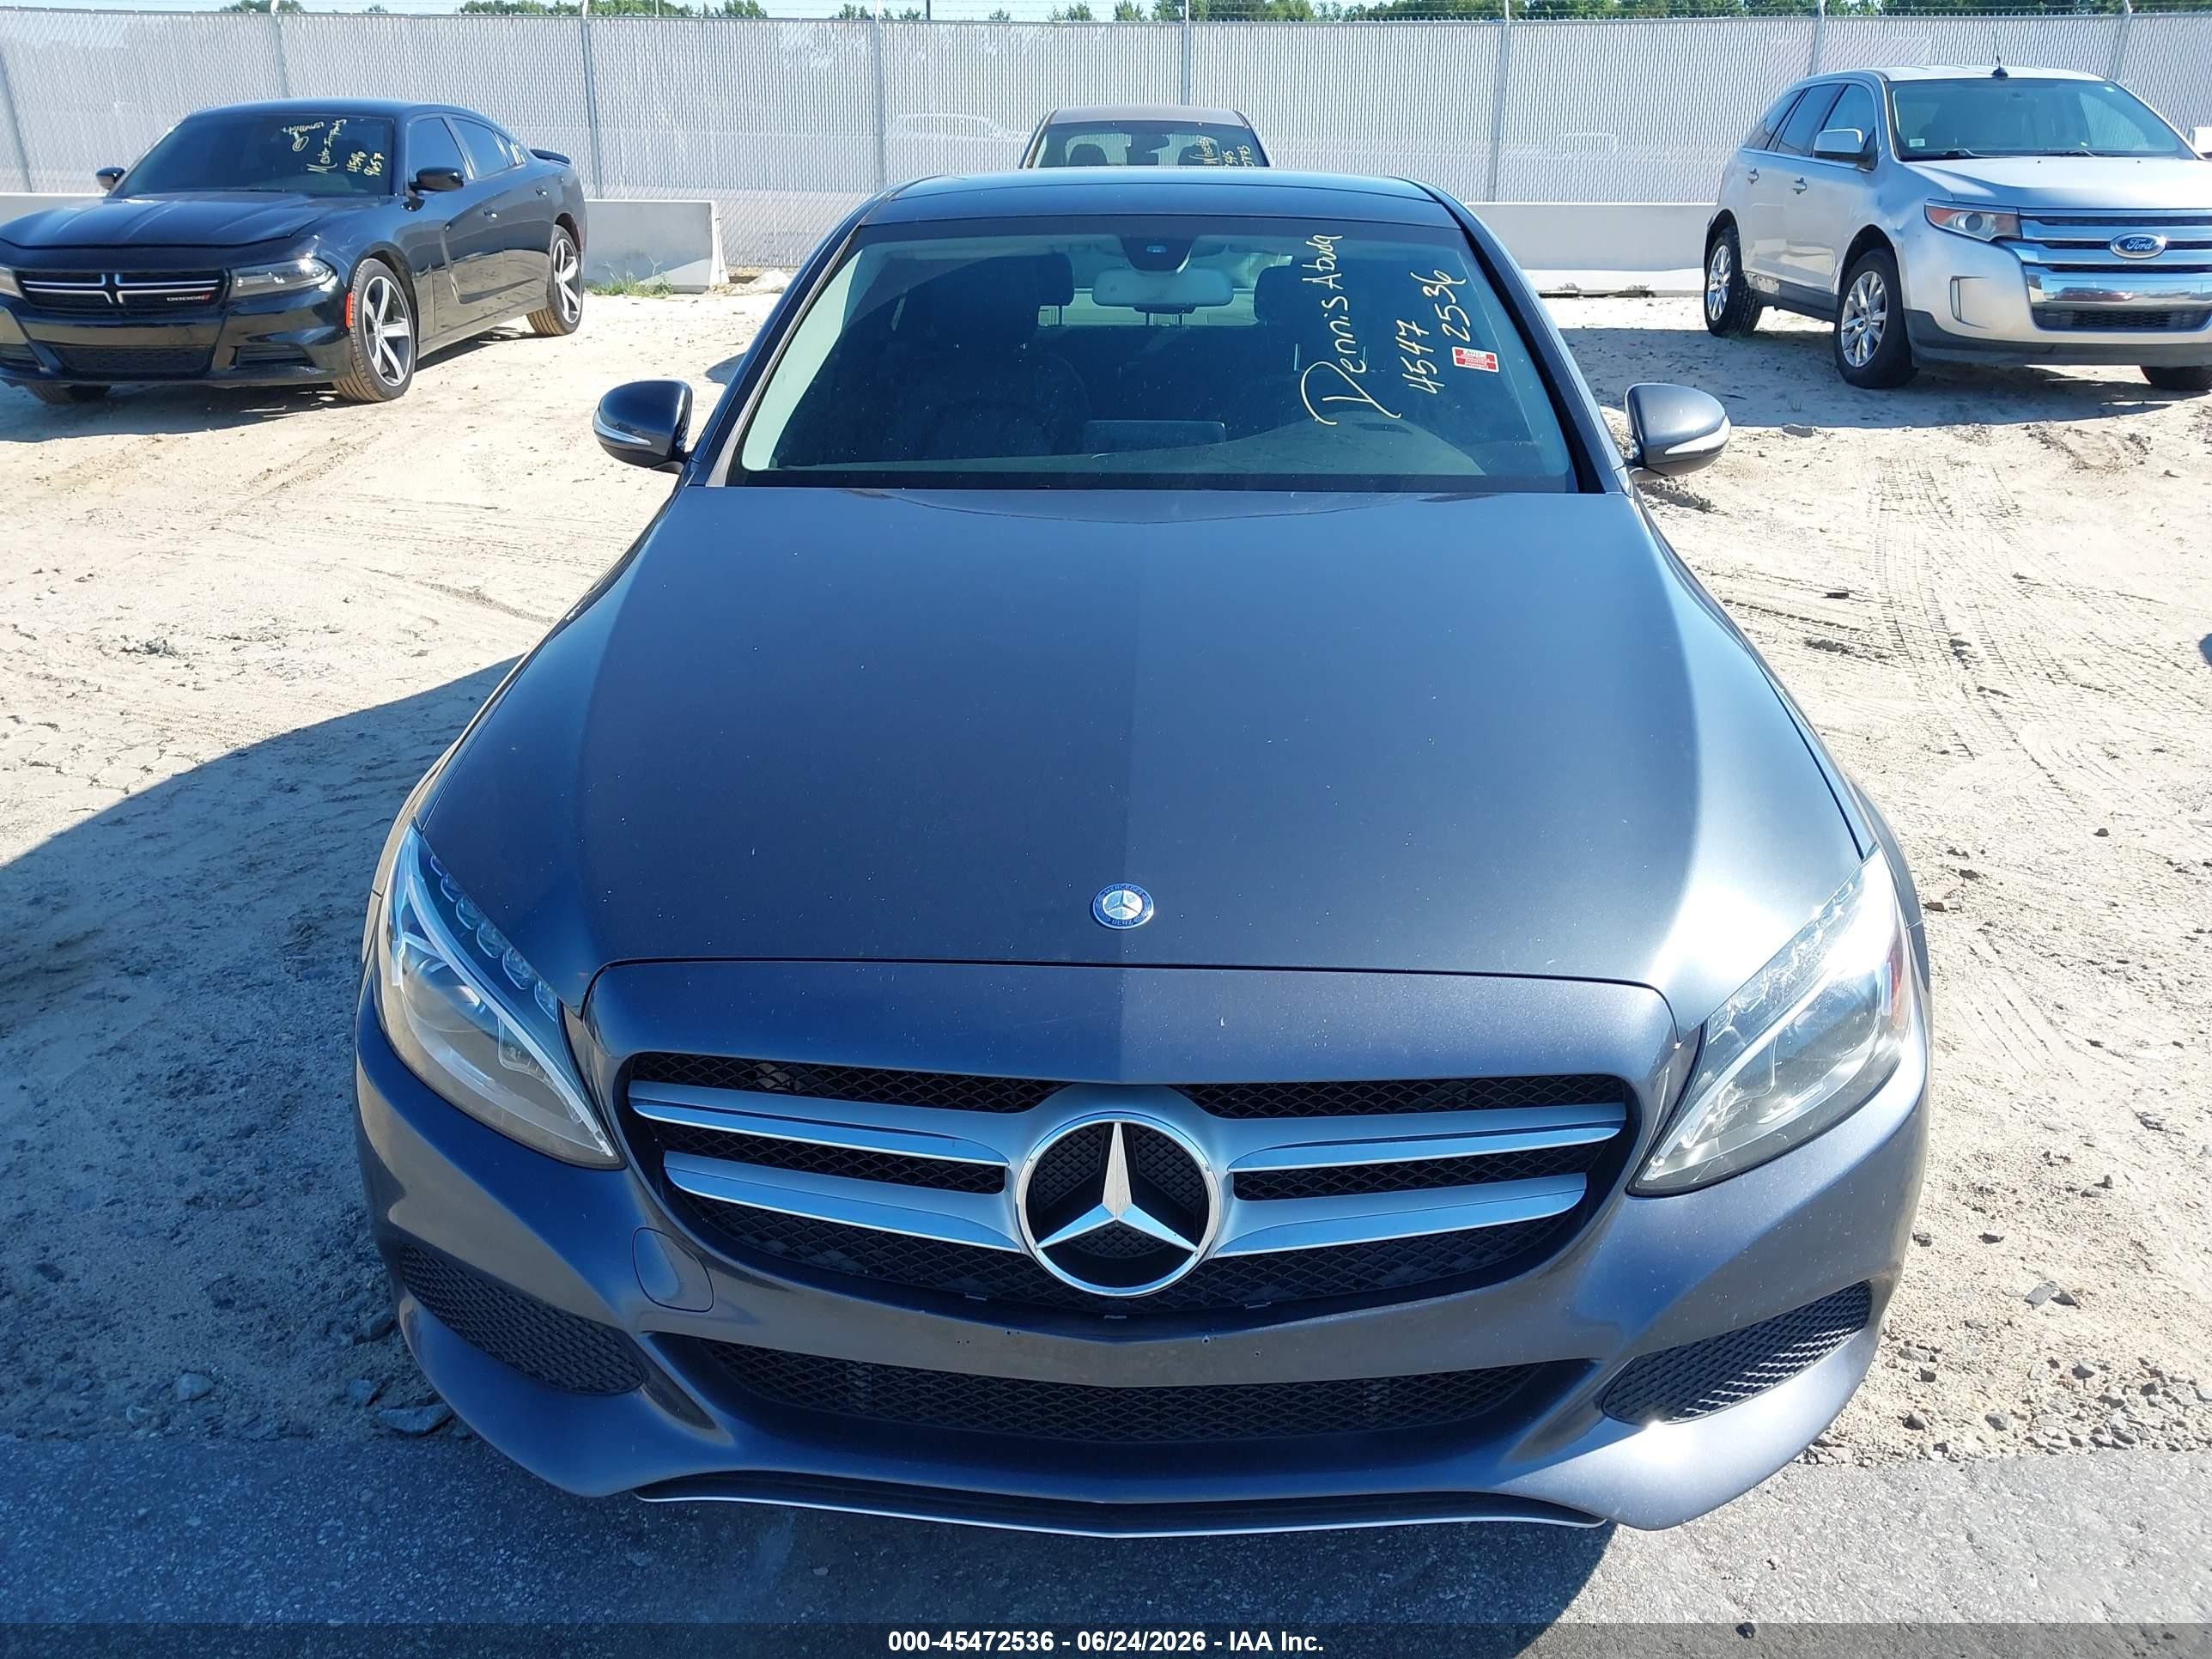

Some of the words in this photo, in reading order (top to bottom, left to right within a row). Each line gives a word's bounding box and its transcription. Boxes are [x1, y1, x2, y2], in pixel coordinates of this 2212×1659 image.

[2126, 238, 2153, 251] Ford
[1409, 269, 1467, 343] 2536
[1300, 295, 1401, 426] Dennis
[1395, 319, 1446, 395] 4547
